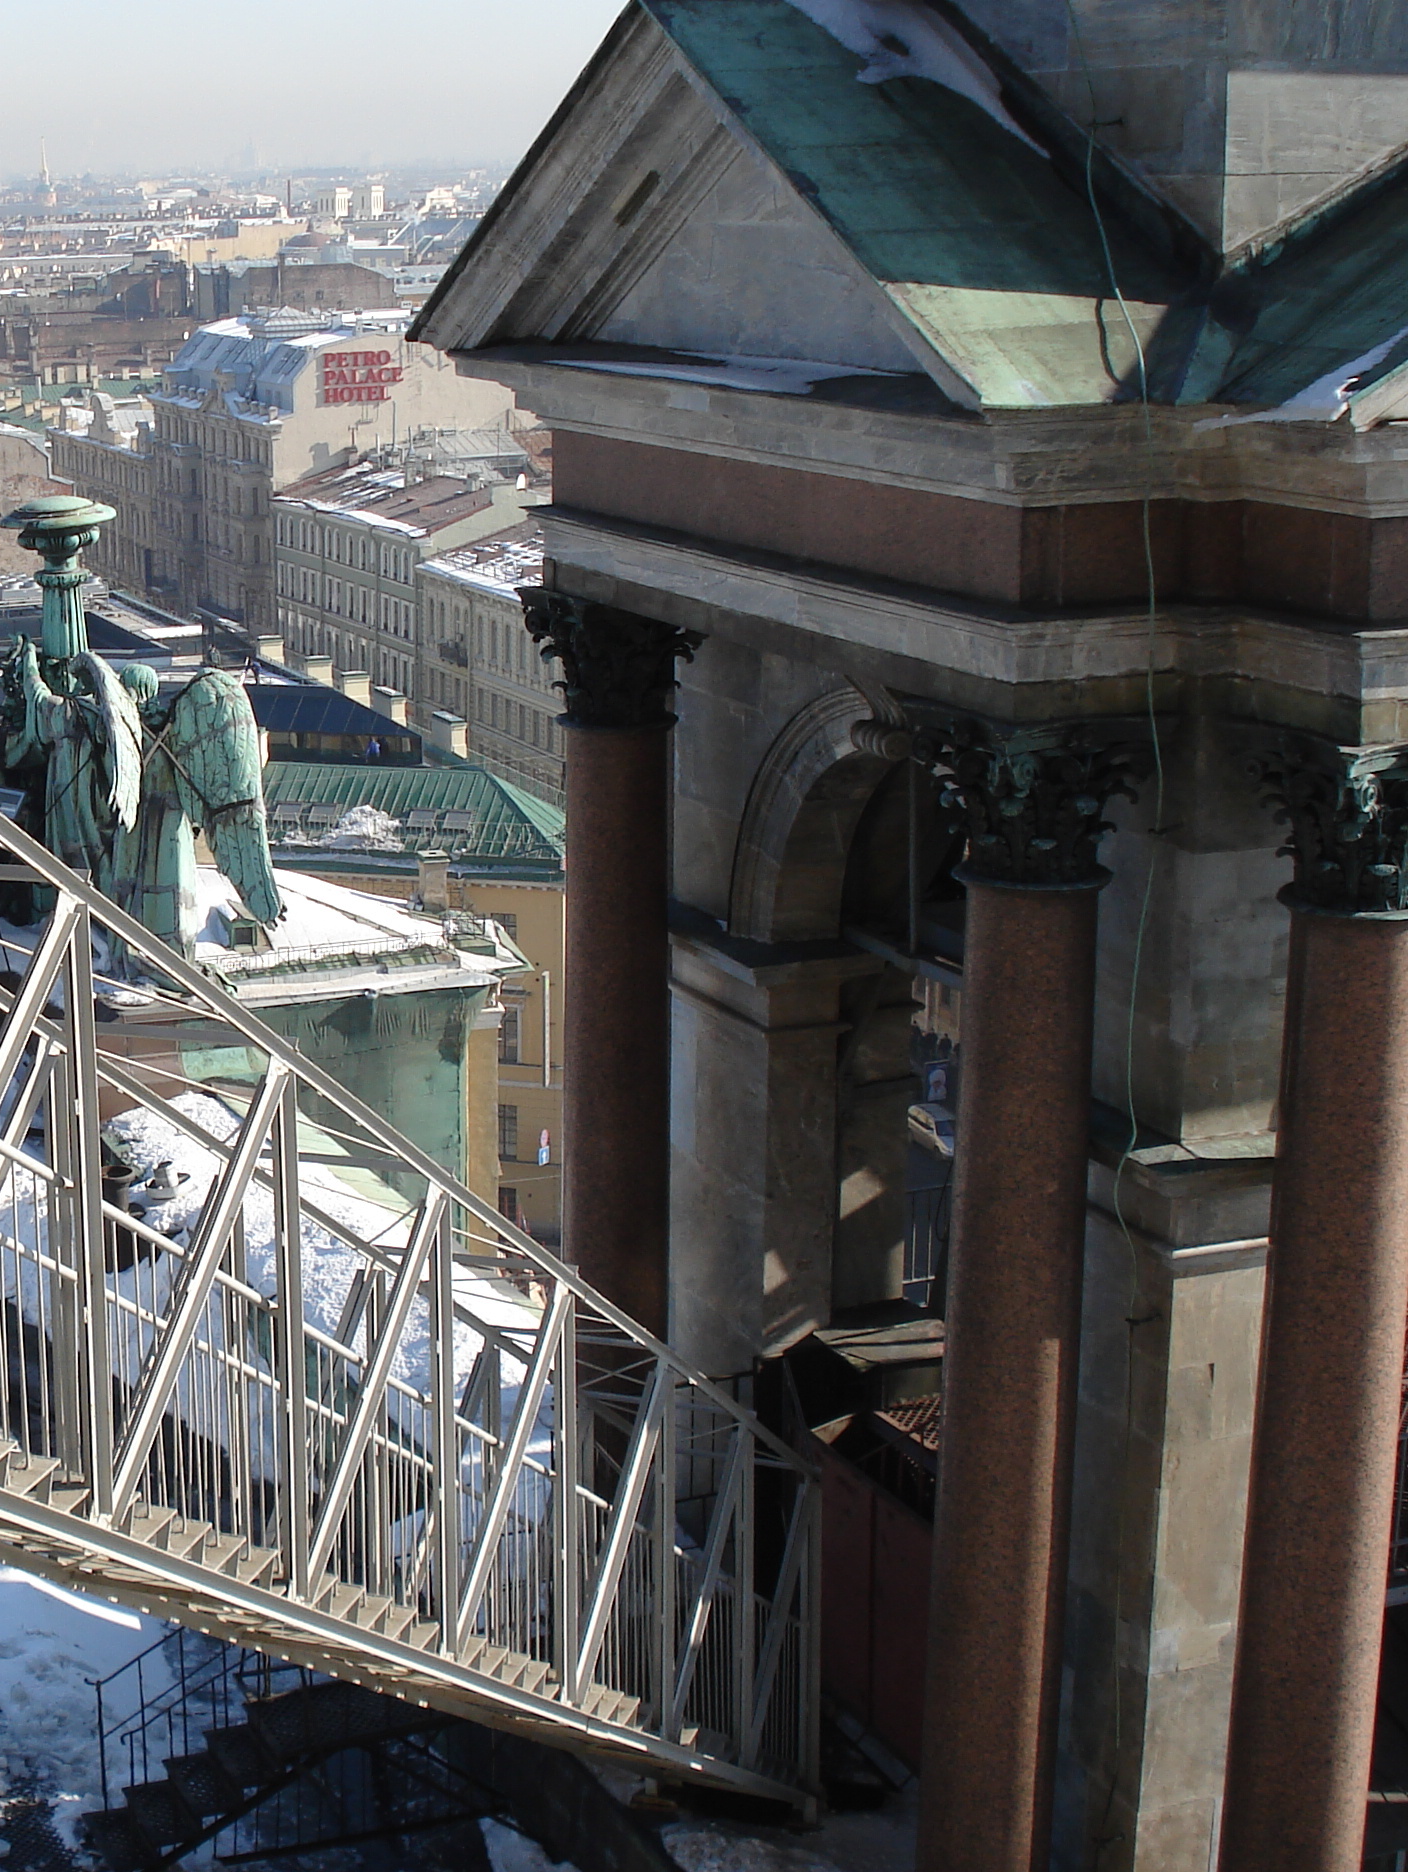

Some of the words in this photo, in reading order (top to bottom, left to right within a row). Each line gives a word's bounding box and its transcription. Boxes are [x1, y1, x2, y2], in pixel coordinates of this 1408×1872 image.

[323, 350, 391, 368] PETRO
[323, 367, 404, 386] PALACE
[323, 386, 391, 403] HOTEL
